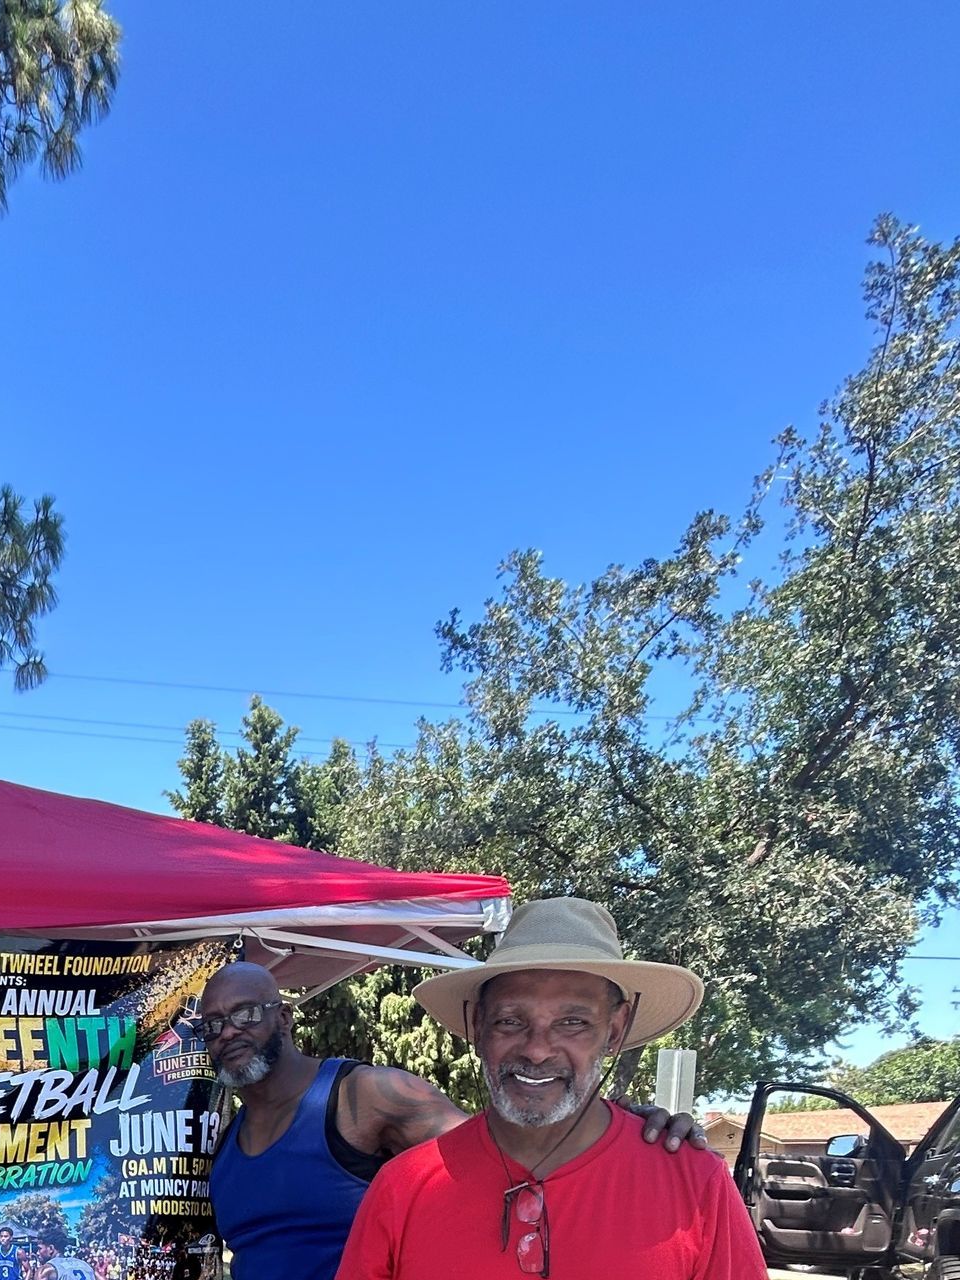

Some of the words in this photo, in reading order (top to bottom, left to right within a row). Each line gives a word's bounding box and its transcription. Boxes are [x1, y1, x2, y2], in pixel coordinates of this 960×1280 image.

[64, 955, 152, 976] FOUNDATION
[1, 989, 101, 1016] ANNUAL
[167, 1069, 202, 1080] FREEDOM
[109, 1110, 194, 1157] JUNE
[199, 1111, 221, 1155] 13
[122, 1157, 167, 1179] (9A.M
[170, 1156, 189, 1174] TIL
[119, 1181, 137, 1198] AT
[140, 1179, 189, 1197] MUNCY
[131, 1200, 146, 1215] IN
[150, 1199, 199, 1216] MODESTO
[201, 1202, 212, 1216] CA
[2, 1267, 9, 1278] 3
